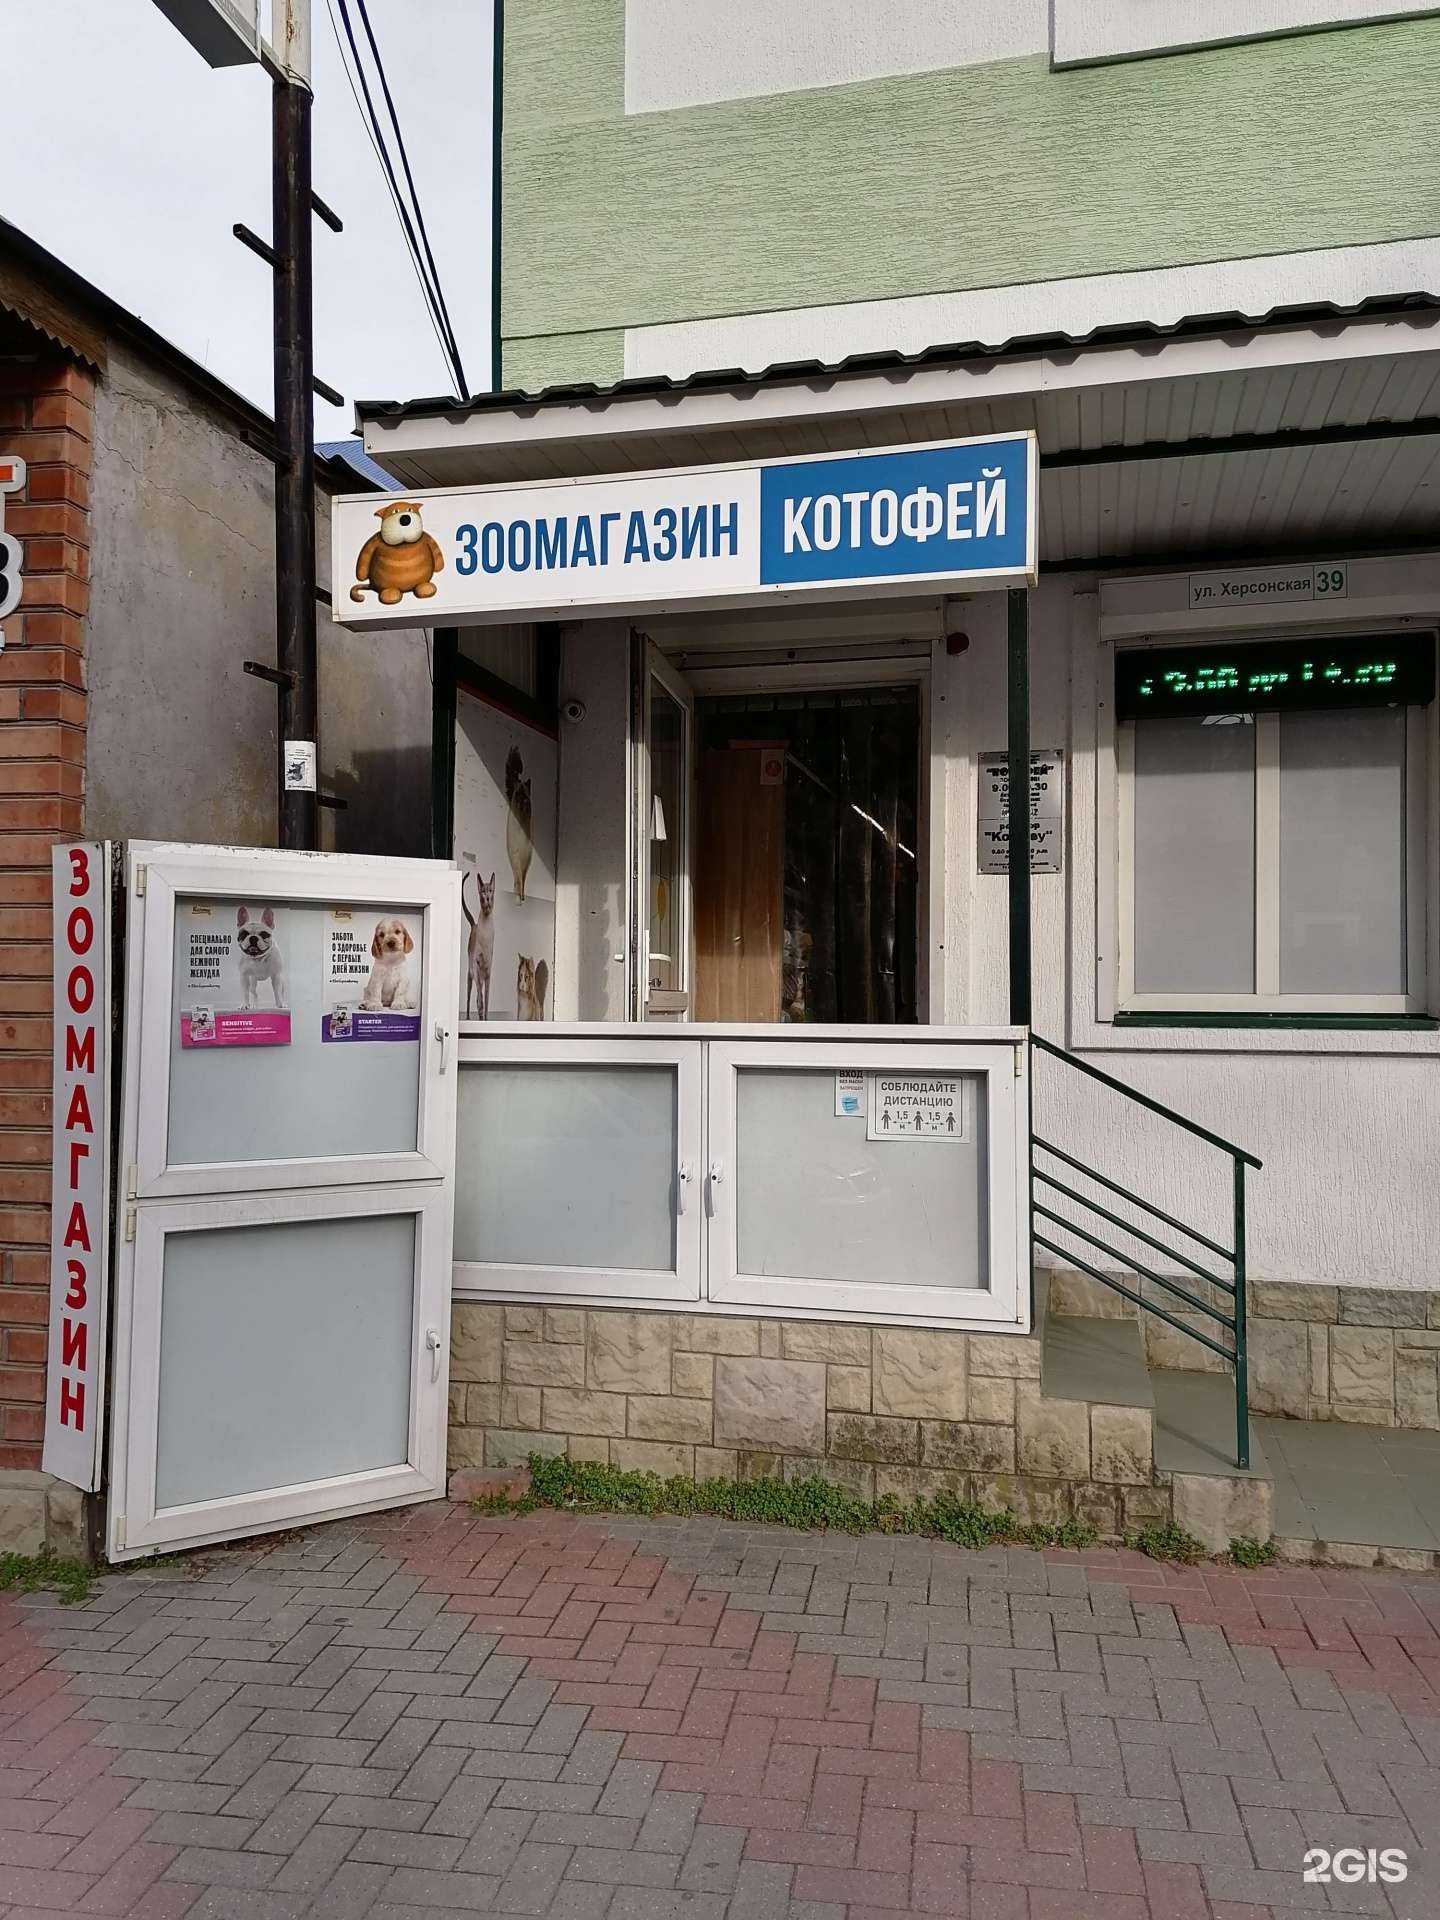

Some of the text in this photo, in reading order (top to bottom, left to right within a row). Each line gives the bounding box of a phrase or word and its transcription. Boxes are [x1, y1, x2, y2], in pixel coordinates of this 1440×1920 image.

[455, 467, 1007, 576] ЗООМАГАЗИН КОТОФЕЙ
[1193, 570, 1344, 600] ул. Херсонская 39
[190, 934, 232, 945] СПЕЦИАЛЬНО
[331, 932, 354, 941] ЗАБОТА
[190, 946, 230, 956] ДЛЯ САМОГО
[331, 943, 367, 953] О ЗДОРОВЬЕ
[331, 953, 361, 963] С ПЕРВЫХ
[190, 968, 221, 979] ЖЕЛУДКА
[331, 963, 370, 975] ДНЕЙ ЖИЗНИ
[839, 1068, 864, 1080] ВХОД
[881, 1080, 957, 1093] СОБЛЮДАЙТЕ
[883, 1096, 954, 1108] ДИСТАНЦИЮ
[896, 1110, 909, 1120] 1,5
[928, 1111, 941, 1121] 1,5
[60, 848, 96, 1433] ЗООМАГАЗИН
